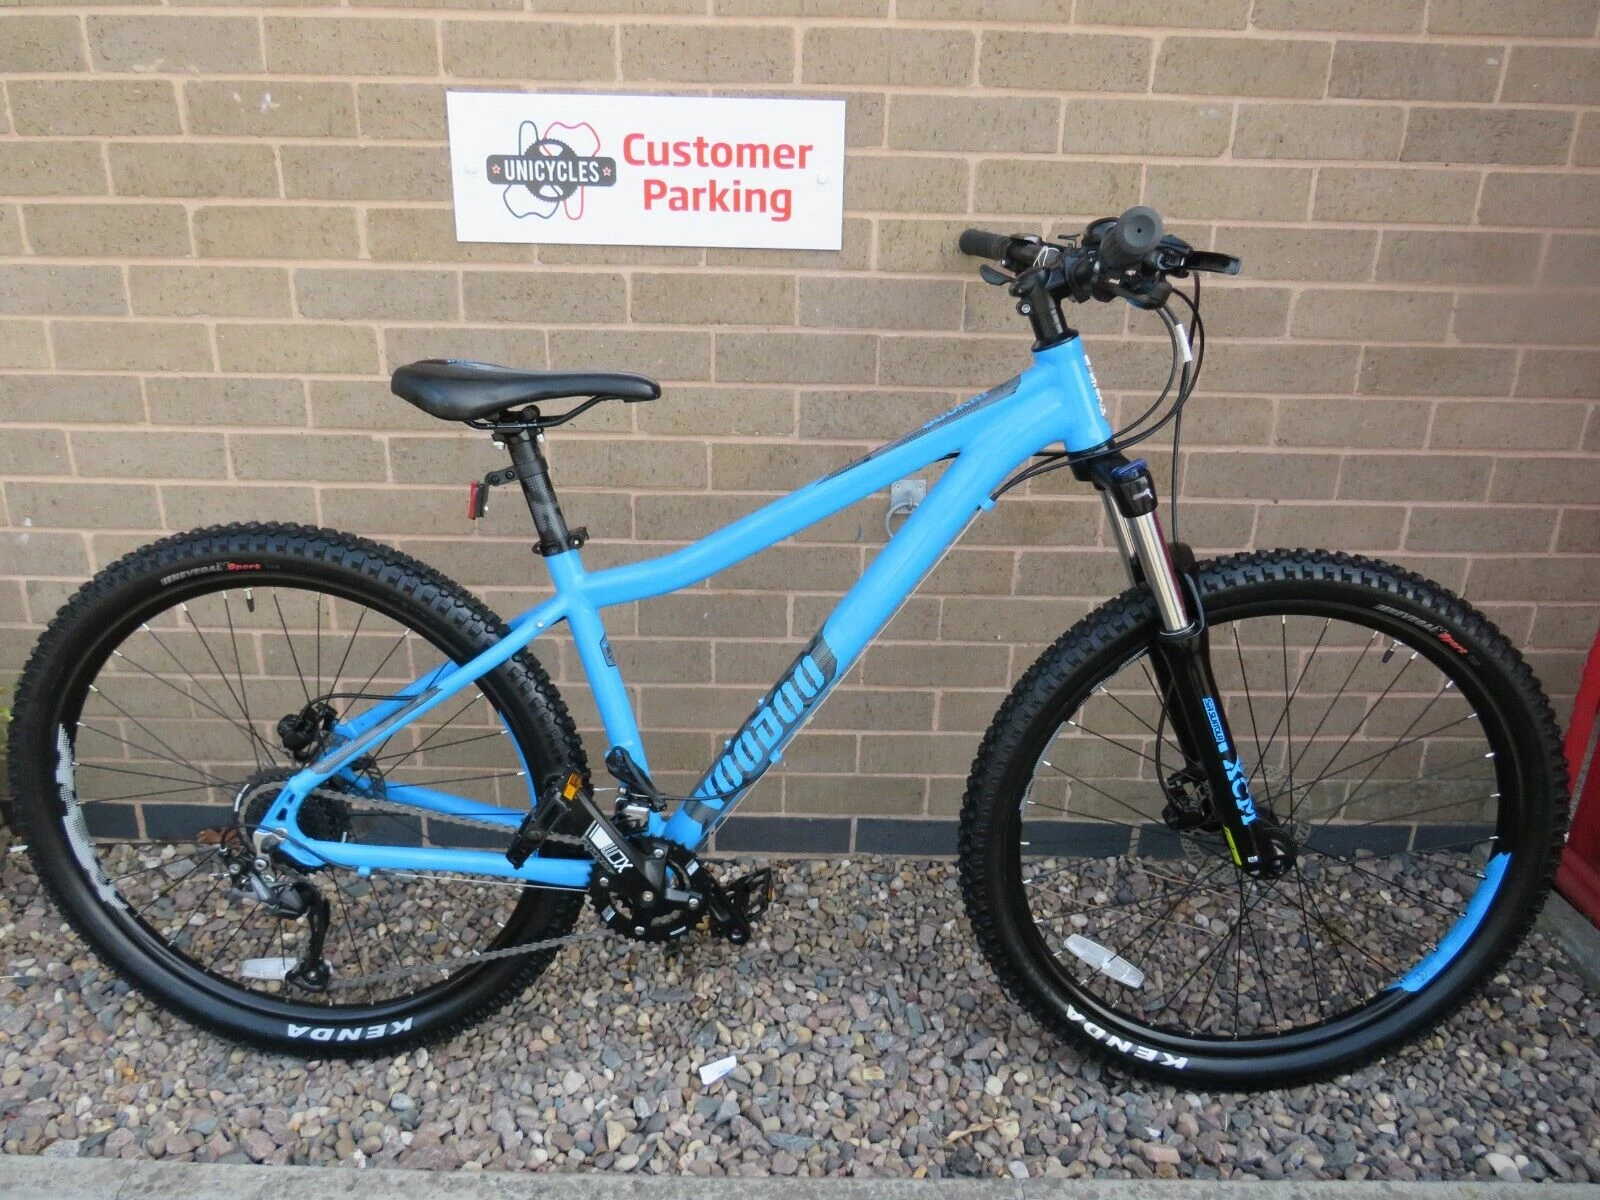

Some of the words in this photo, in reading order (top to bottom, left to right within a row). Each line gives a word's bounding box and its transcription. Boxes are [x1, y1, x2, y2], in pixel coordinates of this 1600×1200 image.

[623, 132, 813, 170] Customer
[504, 159, 600, 183] UNICYCLES
[643, 178, 792, 222] Parking
[227, 562, 262, 572] Sport
[695, 655, 825, 810] VOODOO
[1208, 710, 1224, 741] SUNTOUR
[1222, 755, 1257, 826] XCM
[287, 1016, 413, 1041] KENDA
[1066, 1003, 1189, 1069] KENDA
